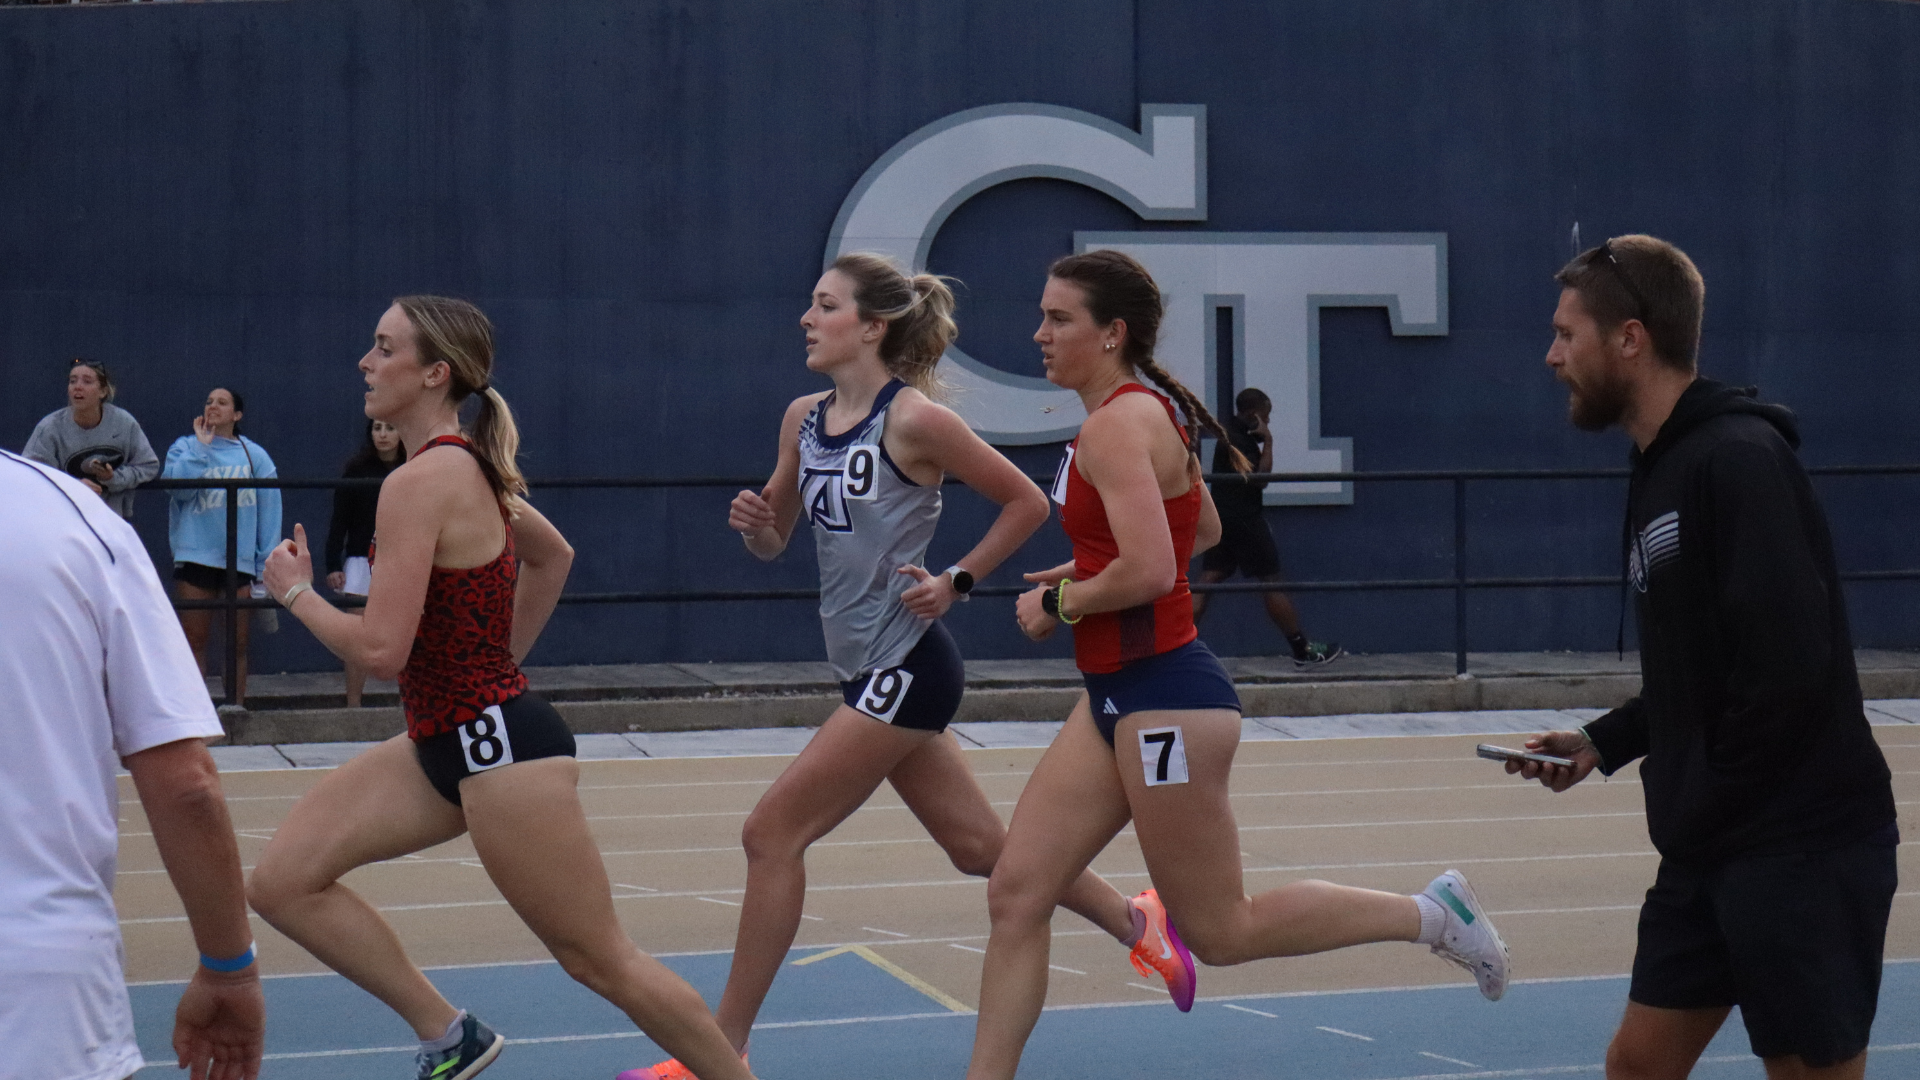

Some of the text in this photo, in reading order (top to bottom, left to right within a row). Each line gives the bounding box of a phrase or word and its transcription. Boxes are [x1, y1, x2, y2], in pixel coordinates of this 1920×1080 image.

[847, 449, 873, 496] 9
[865, 667, 903, 715] 9
[465, 713, 504, 766] 8
[1144, 731, 1176, 781] 7
